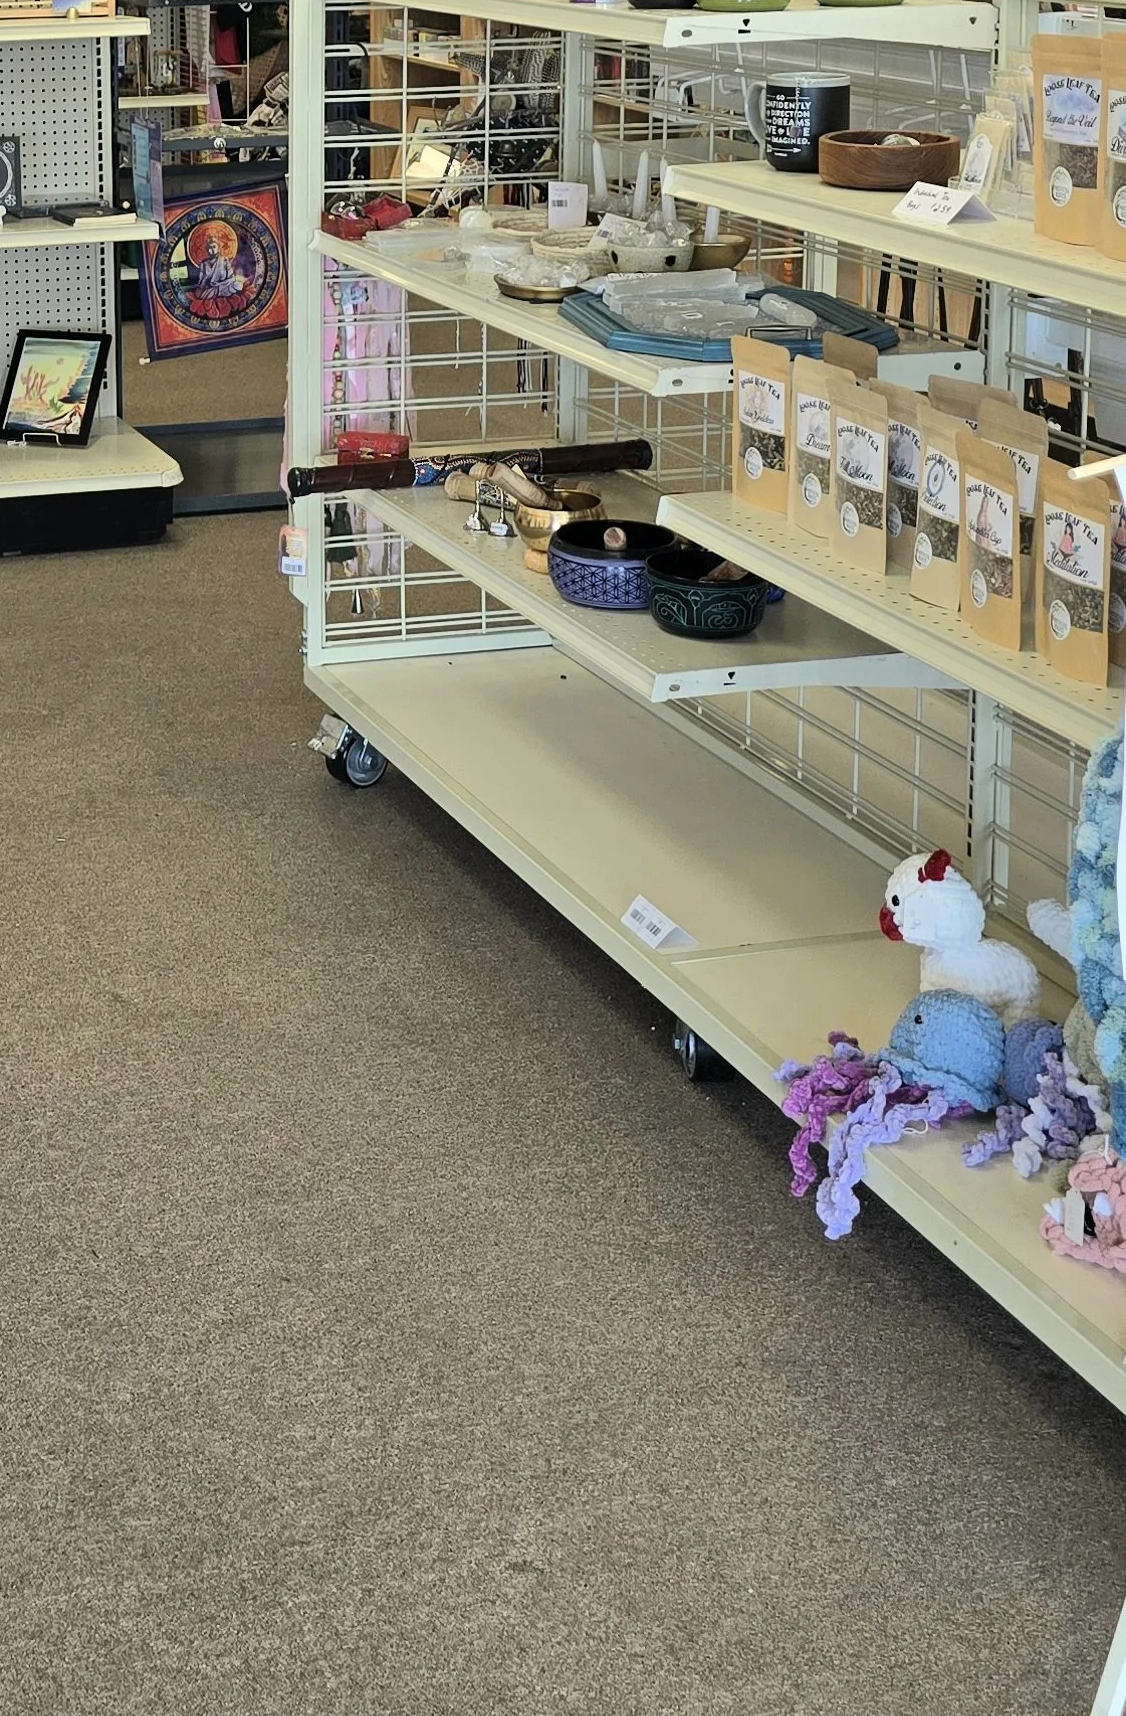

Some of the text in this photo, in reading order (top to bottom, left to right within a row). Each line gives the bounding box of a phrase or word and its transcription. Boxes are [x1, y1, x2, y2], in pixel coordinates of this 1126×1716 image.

[1085, 84, 1101, 104] TEA
[768, 384, 780, 400] TEA
[866, 434, 879, 452] TEA
[1017, 454, 1032, 475] TEA
[995, 494, 1008, 516] TEA
[1082, 523, 1098, 546] TEA
